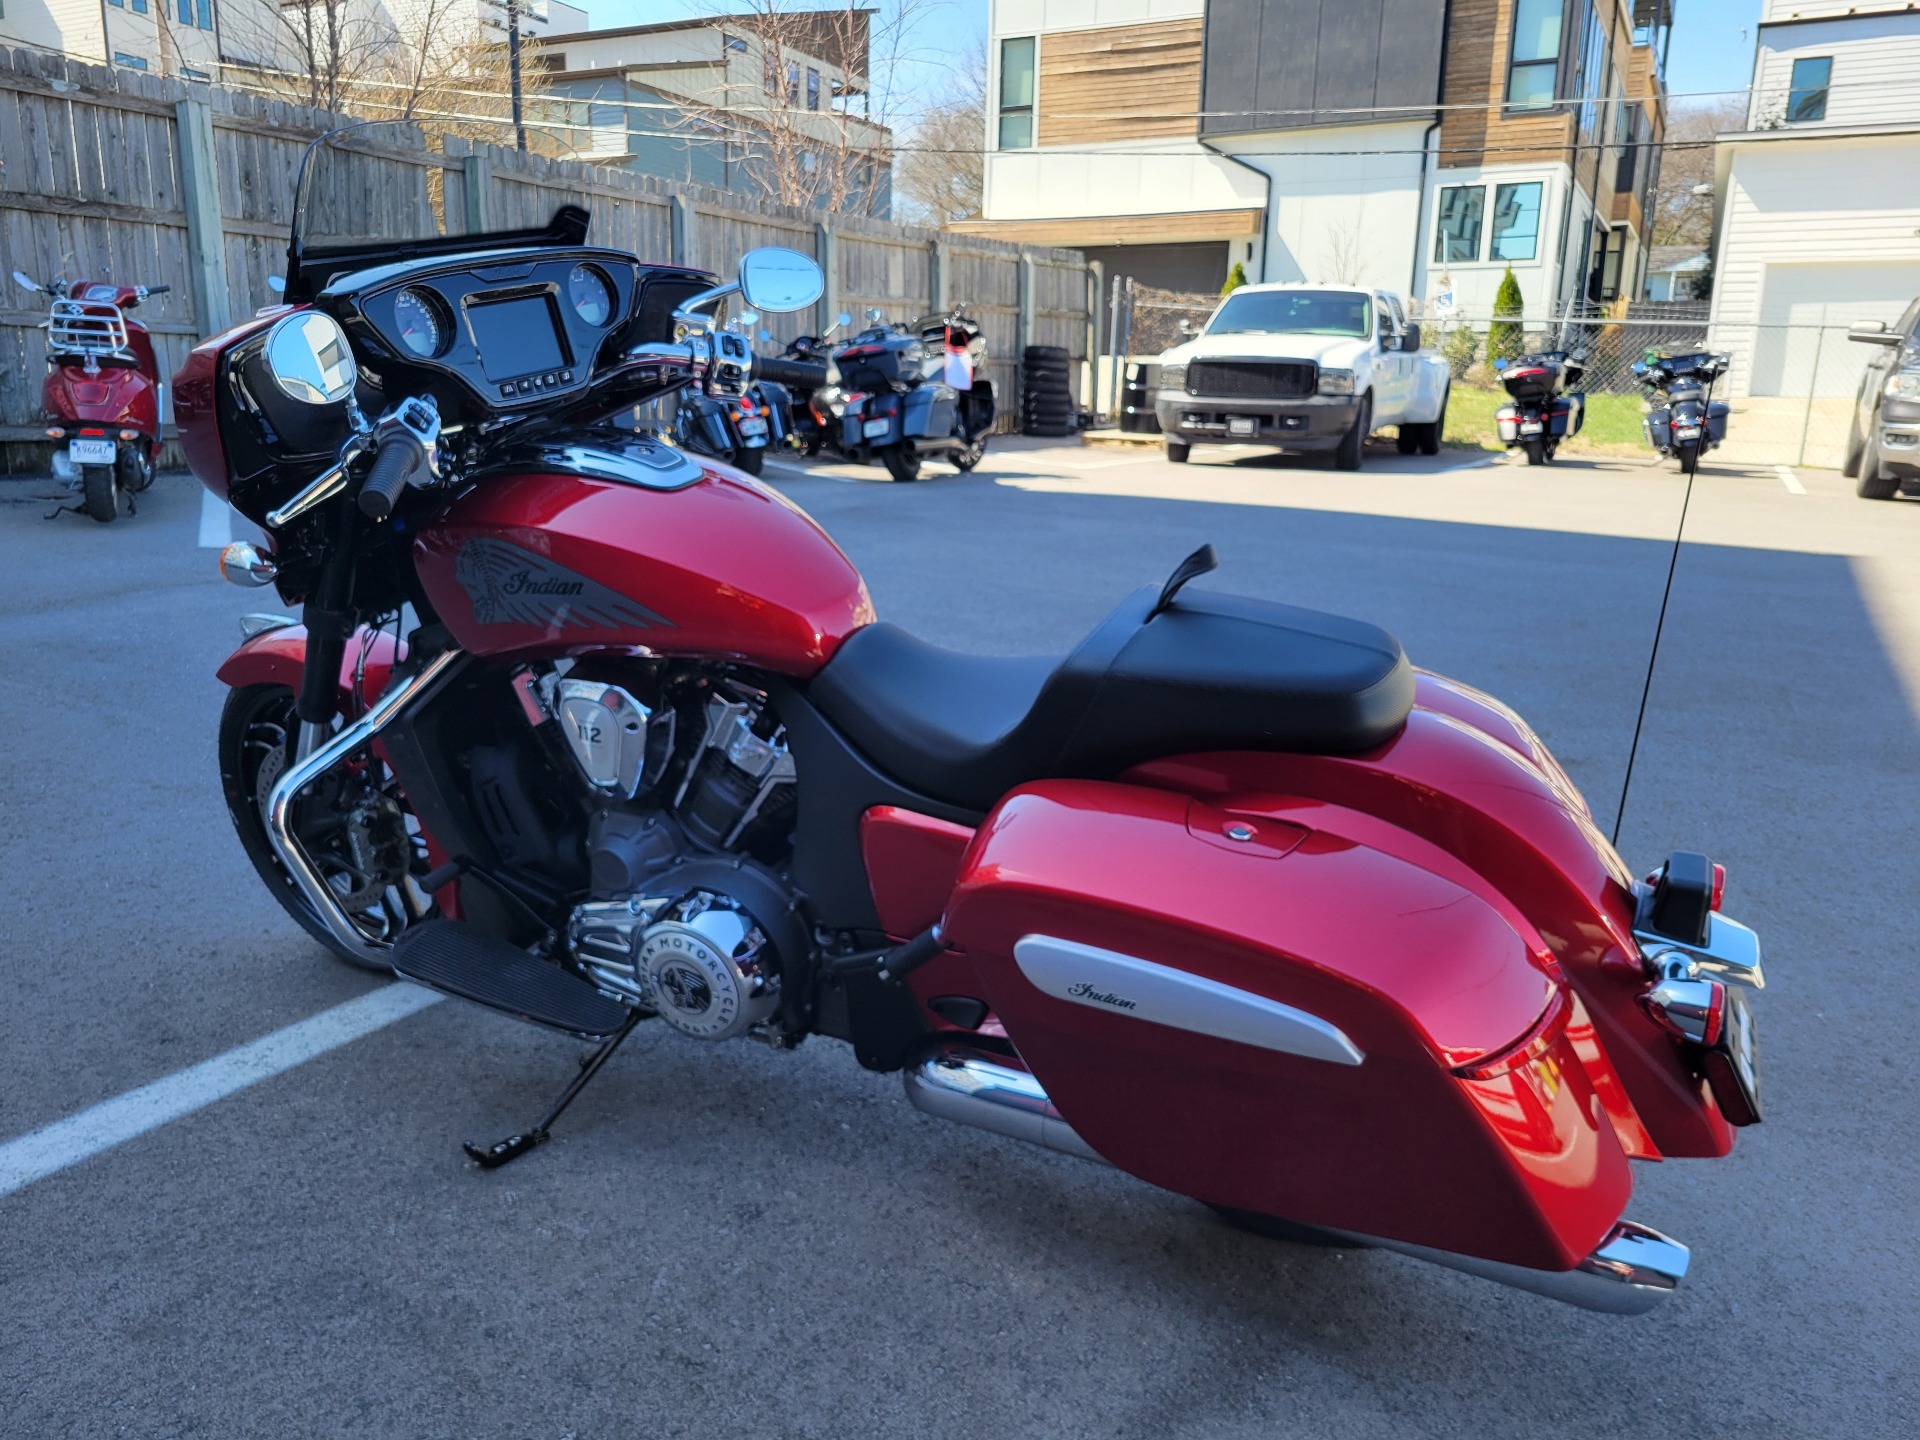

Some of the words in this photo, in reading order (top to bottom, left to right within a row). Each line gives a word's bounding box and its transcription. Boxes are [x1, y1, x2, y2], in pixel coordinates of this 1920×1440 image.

[503, 570, 584, 596] Indian
[577, 724, 602, 744] 112
[659, 937, 734, 1025] MOTORCYCLE
[1067, 983, 1137, 1010] Indian
